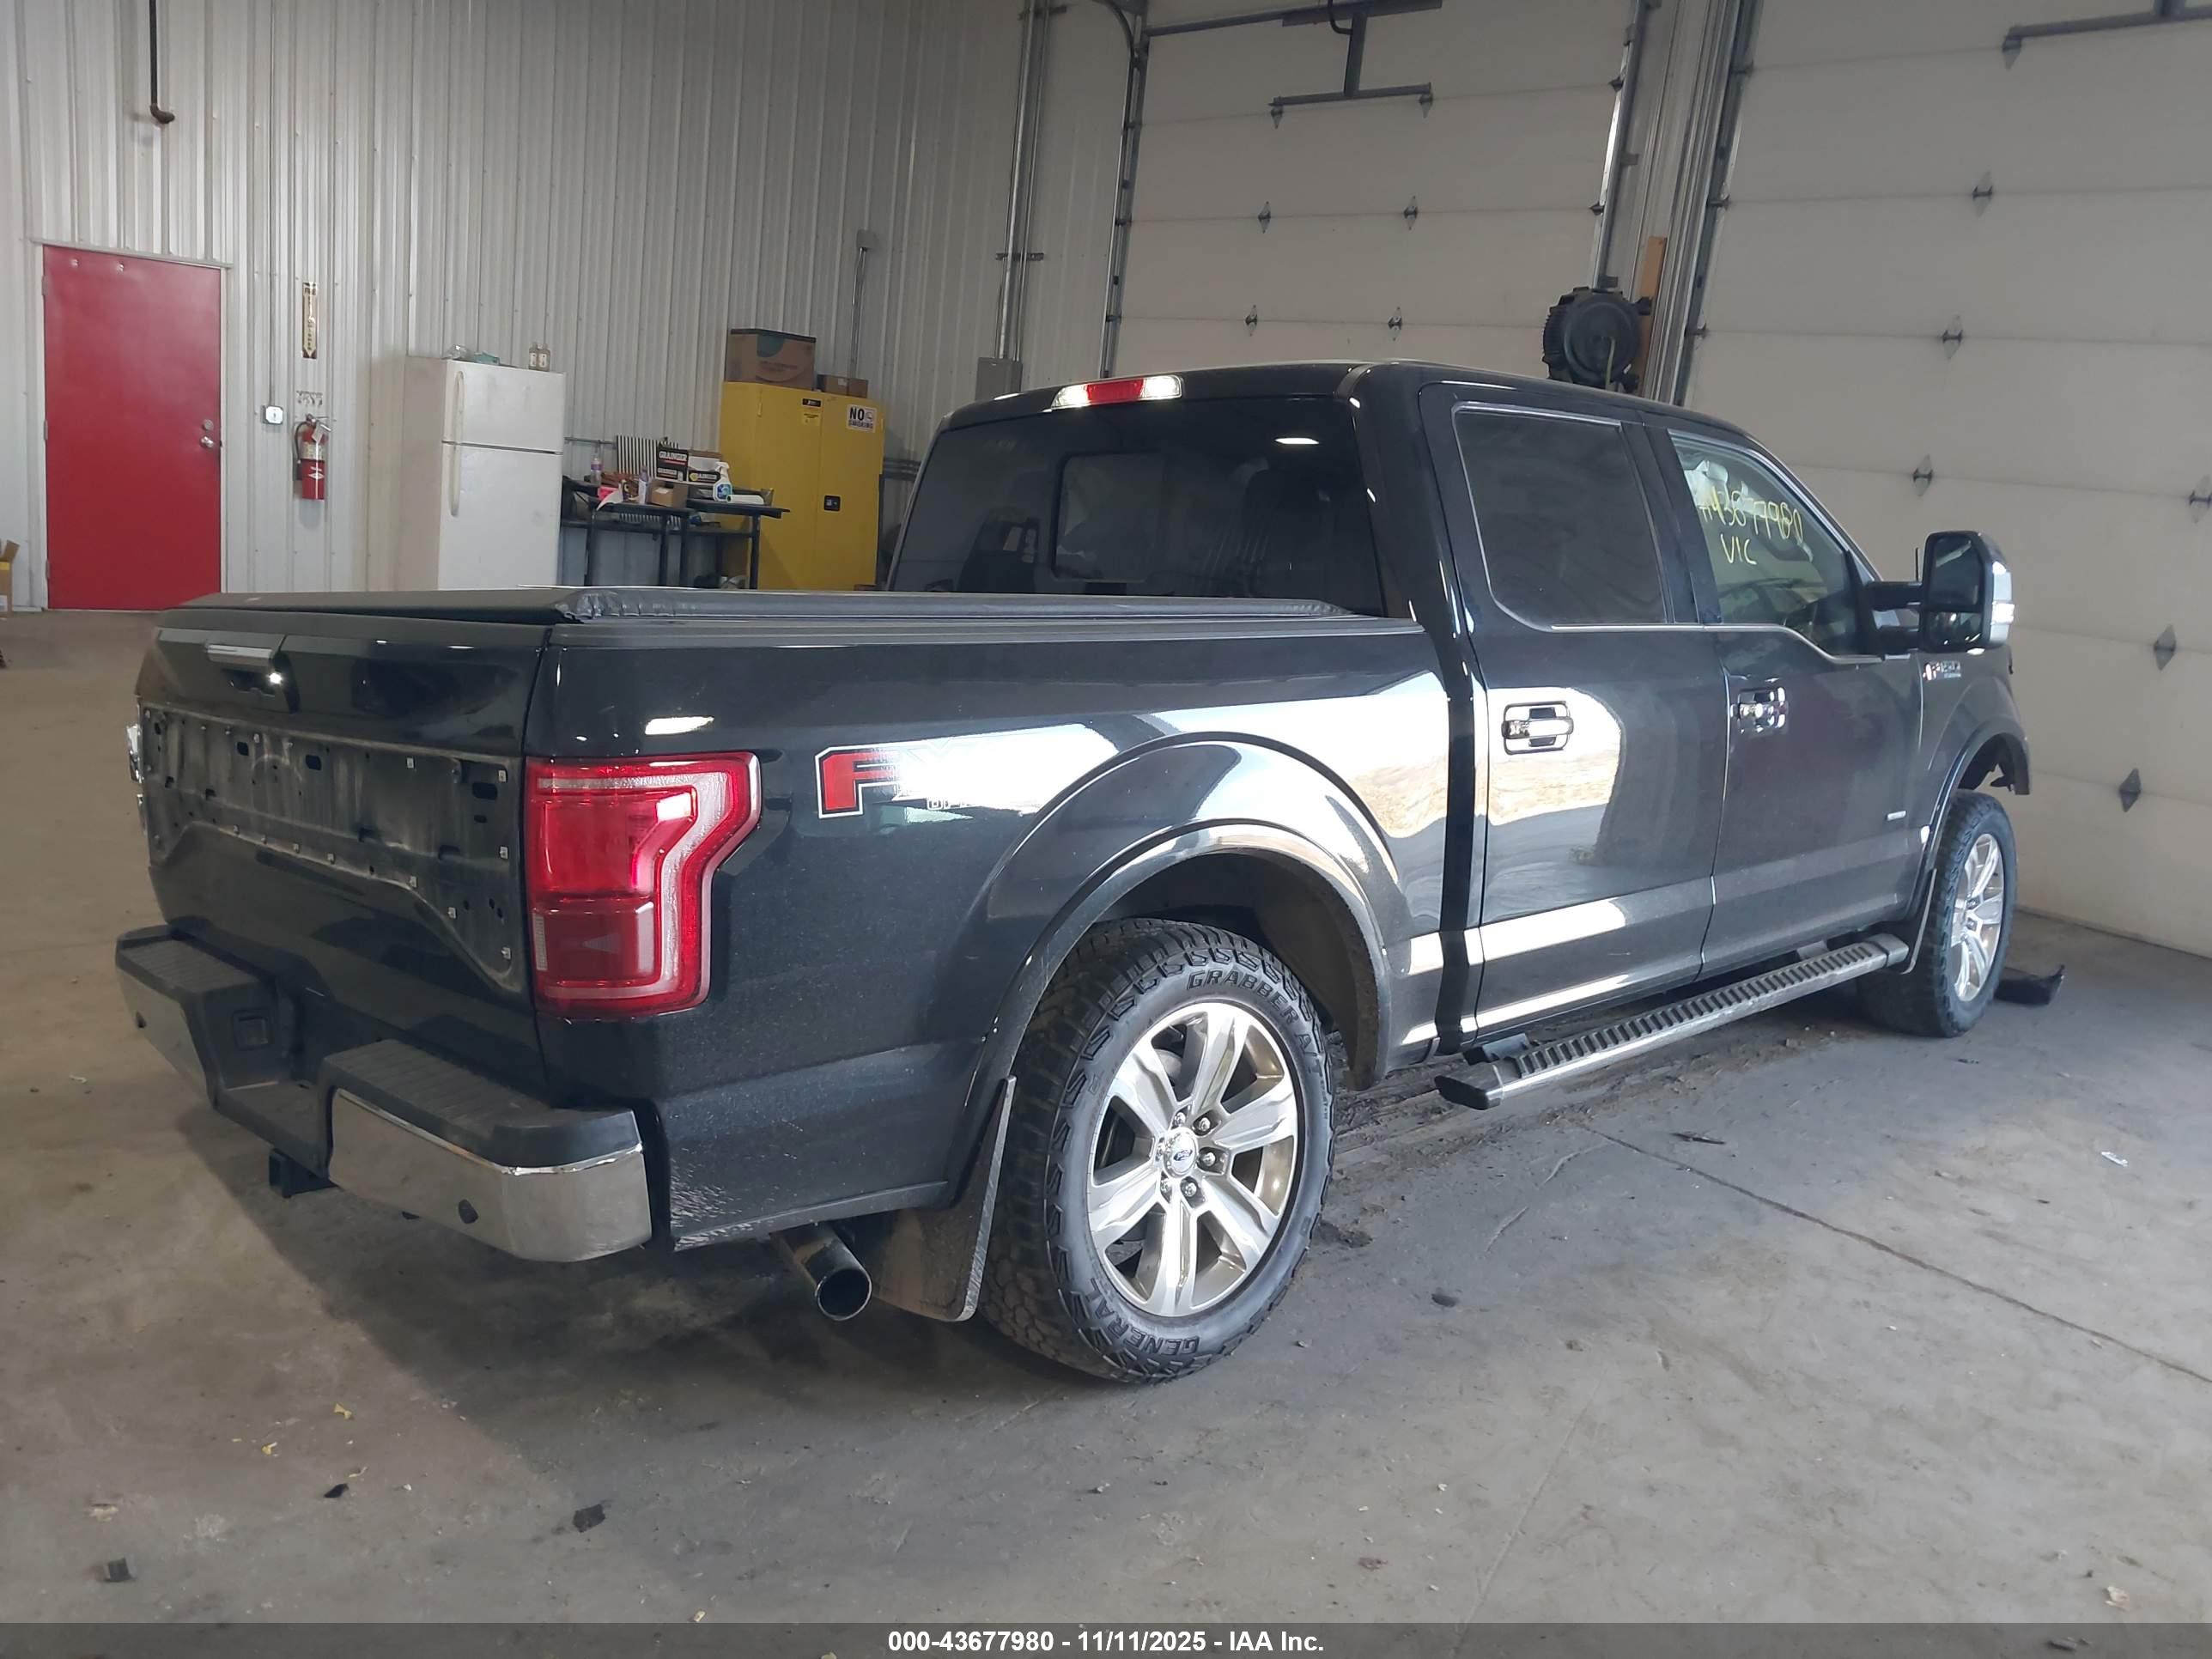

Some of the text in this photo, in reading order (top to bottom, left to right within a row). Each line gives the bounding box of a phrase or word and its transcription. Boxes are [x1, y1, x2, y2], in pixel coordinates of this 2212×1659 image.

[848, 419, 873, 429] SMOKING
[850, 406, 866, 421] NO
[1720, 533, 1758, 565] VIC
[1187, 969, 1300, 1025] GRABBER
[1085, 1277, 1200, 1357] GENERAL
